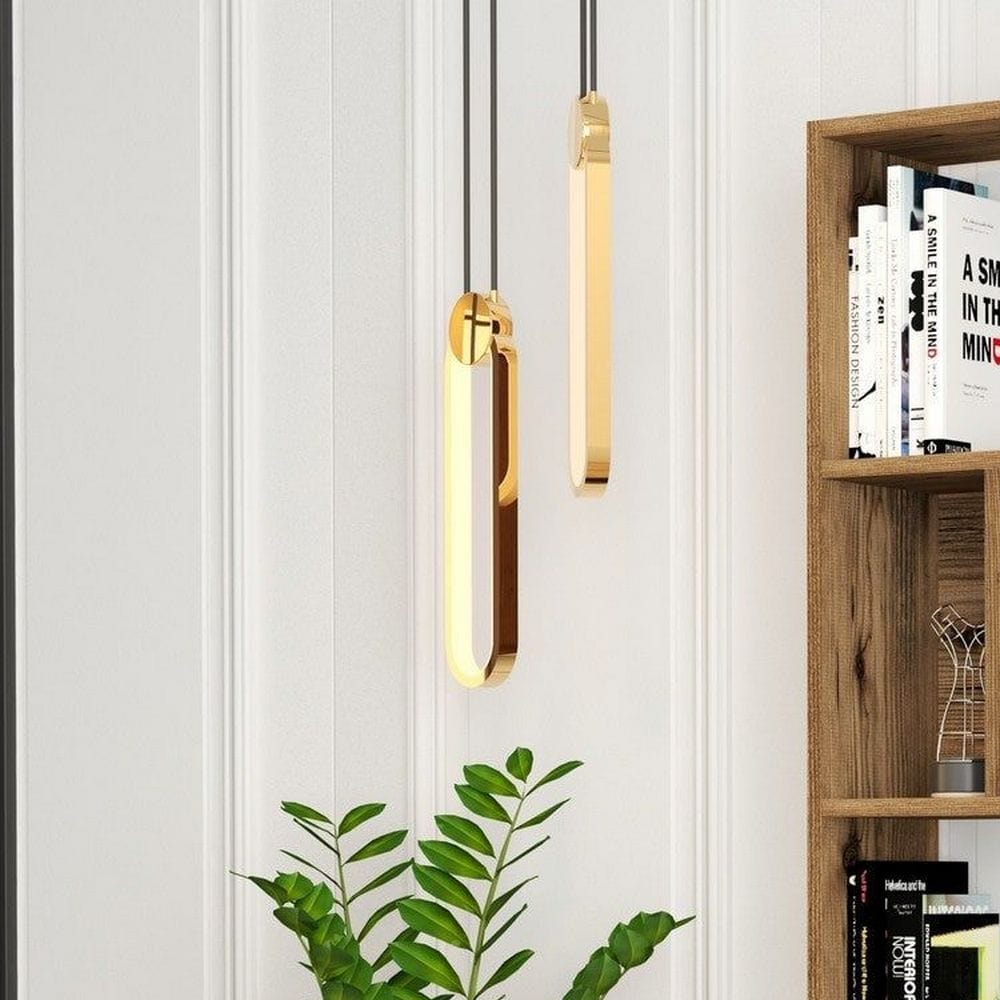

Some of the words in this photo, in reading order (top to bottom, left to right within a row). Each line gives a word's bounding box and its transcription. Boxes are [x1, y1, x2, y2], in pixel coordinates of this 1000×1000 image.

[927, 214, 937, 223] A
[927, 228, 937, 269] SMILE
[927, 273, 937, 288] IN
[962, 253, 974, 282] A
[877, 296, 886, 324] zen
[927, 292, 937, 317] THE
[962, 292, 979, 322] IN
[851, 295, 860, 355] FASHION
[927, 321, 937, 359] MIND
[850, 359, 860, 409] DESIGN
